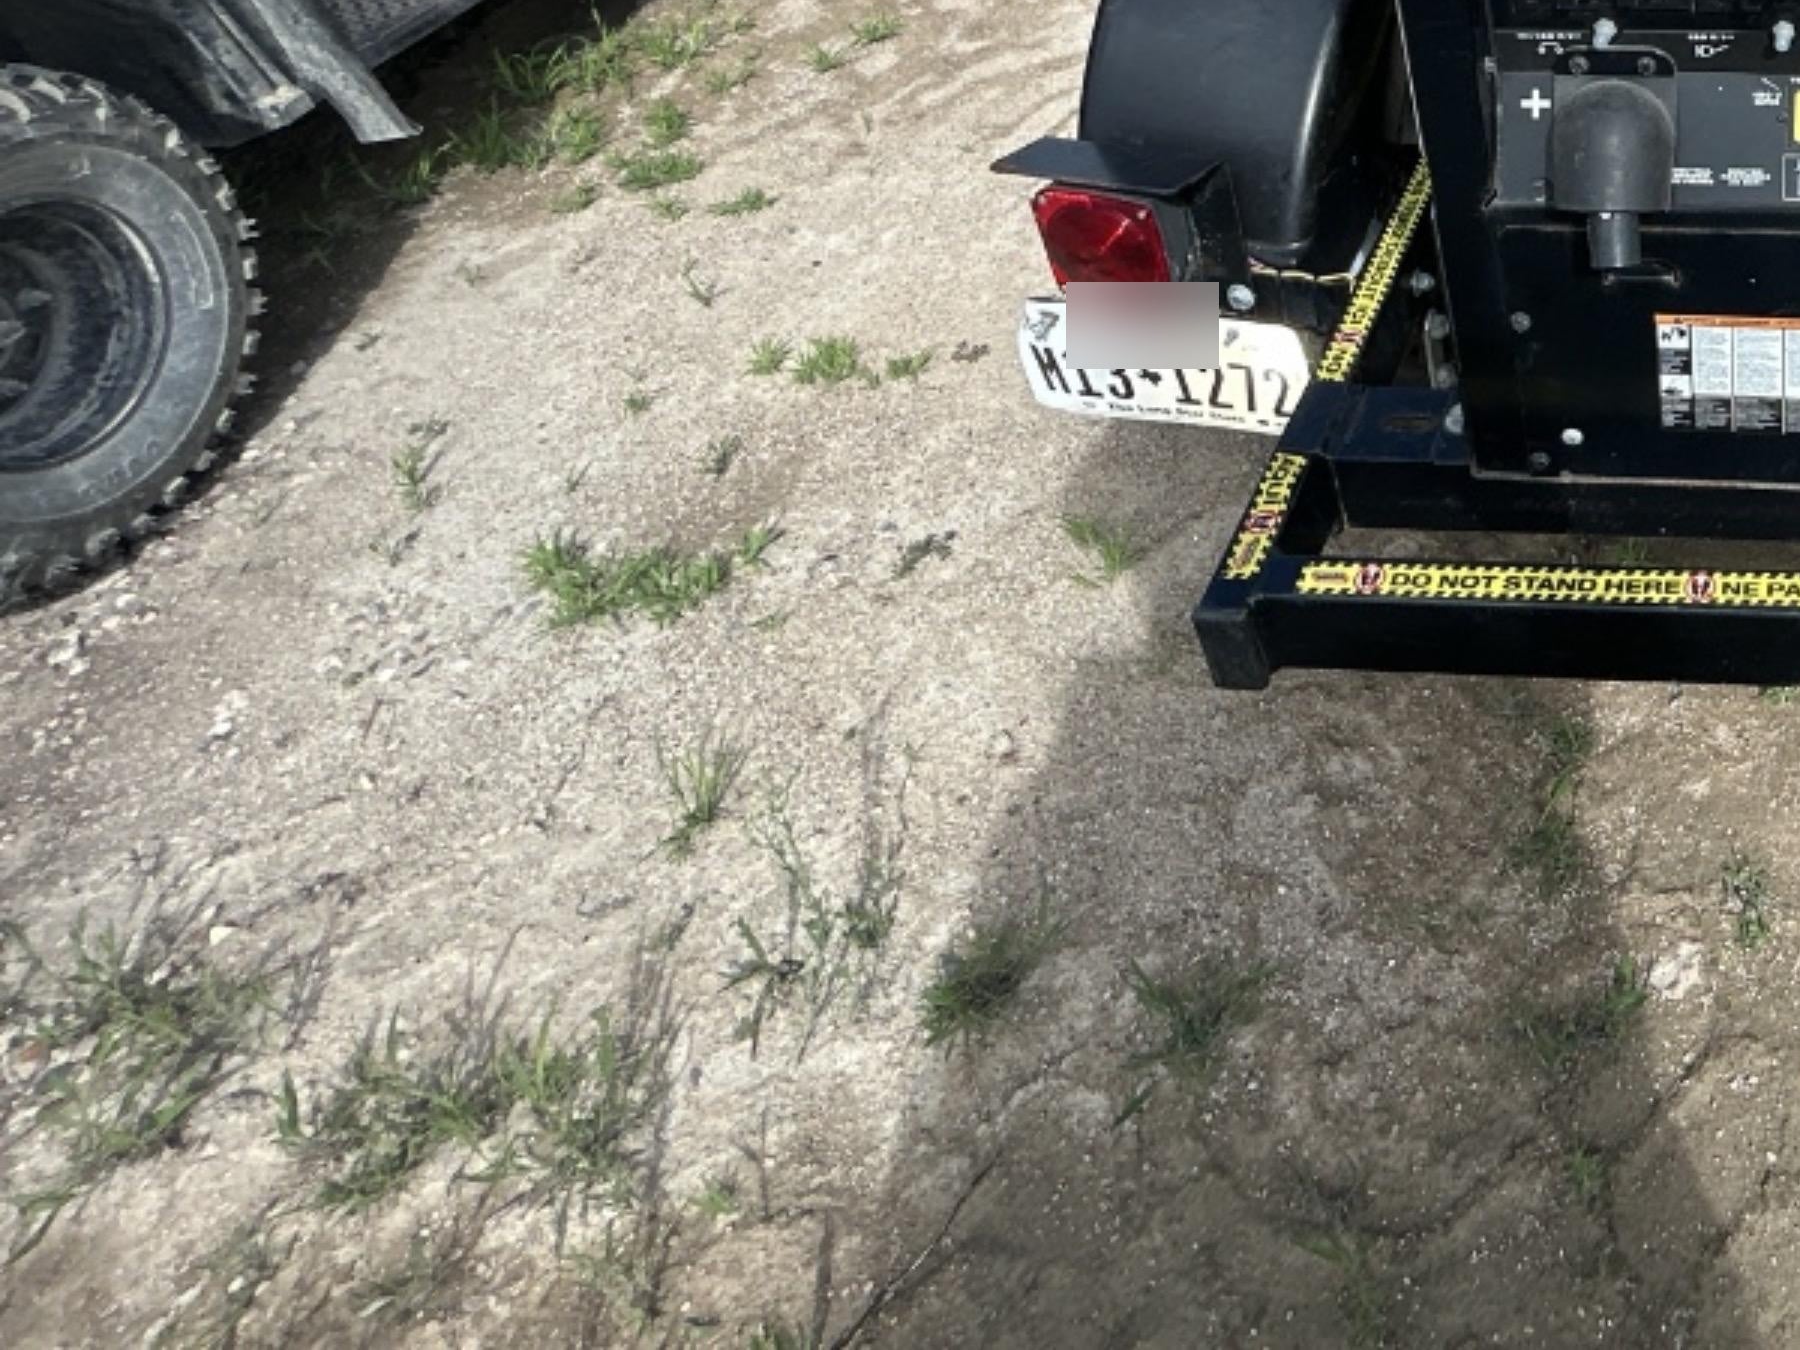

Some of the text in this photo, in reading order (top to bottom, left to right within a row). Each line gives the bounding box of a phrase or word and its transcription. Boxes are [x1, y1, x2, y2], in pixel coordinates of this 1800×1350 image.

[1389, 572, 1683, 595] DO NOT STAND HERE
[1720, 580, 1761, 597] NE
